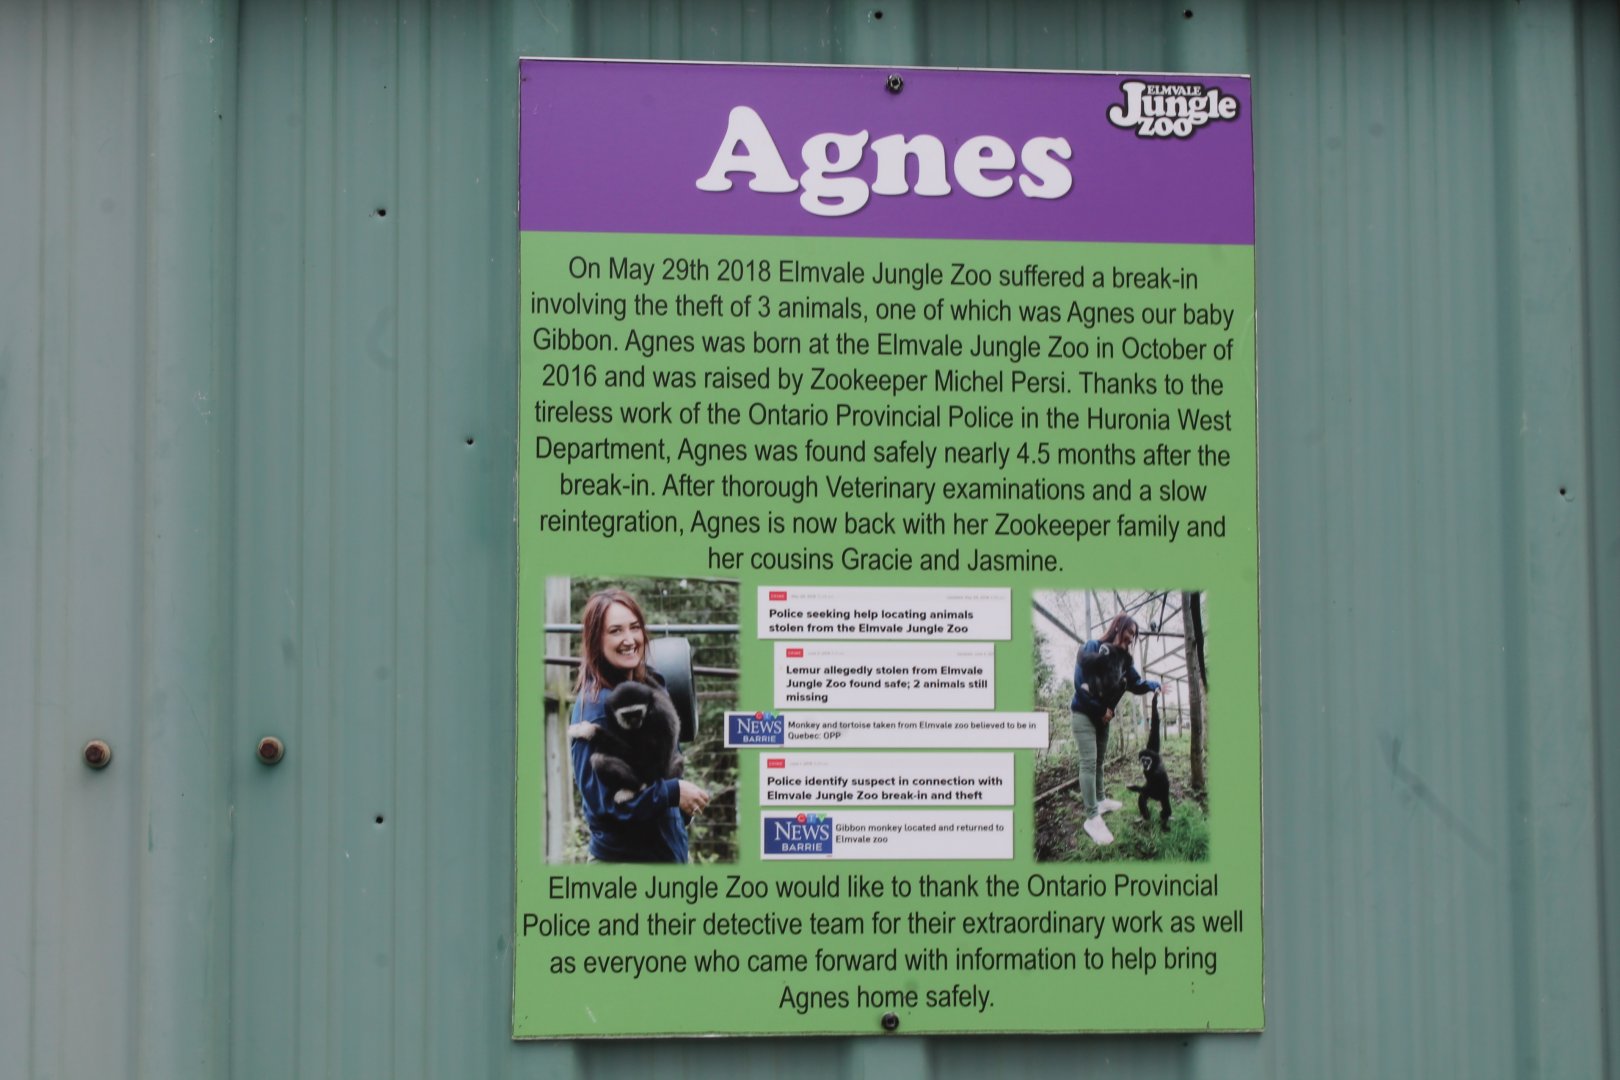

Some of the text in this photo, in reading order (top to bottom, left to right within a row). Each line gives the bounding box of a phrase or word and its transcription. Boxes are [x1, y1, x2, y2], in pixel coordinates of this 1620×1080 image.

[1147, 85, 1201, 96] ELMVALE
[1109, 81, 1237, 126] Jungle
[695, 105, 1073, 217] Agnes
[569, 256, 1197, 291] On May 29th 2018 Elmvale Jungle Zoo suffered a break-in
[532, 291, 1234, 331] involving the theft of 3 animals, one of which was Agnes our baby
[542, 364, 1223, 397] 2016 and was raised by Zookeeper Michel Persi. Thanks to the
[536, 436, 1230, 470] Department, Agnes was found safely nearly 4.5 months after the
[540, 509, 1225, 543] reintegration, Agnes is now back with her Zookeeper family and
[709, 546, 1063, 572] her cousins Gracie and Jasmine.
[769, 609, 973, 621] Police seeking help locating animals
[769, 623, 968, 635] stolen from the Elmvale Jungle Zoo
[786, 665, 983, 676] Lemur allegedly stolen from Elmvale
[787, 679, 987, 690] Jungle Zoo found safe; 2 animals still
[786, 692, 828, 703] missing
[737, 718, 782, 735] NEWS
[788, 721, 820, 730] Monkey
[822, 721, 837, 729] and
[839, 721, 871, 729] tortoise
[873, 721, 896, 729] taken
[898, 721, 917, 729] from
[919, 721, 952, 729] Elmvale
[970, 721, 1006, 729] believed
[1028, 721, 1036, 729] in
[742, 735, 777, 743] BARRIE
[788, 732, 822, 740] Quebec:
[767, 776, 1003, 788] Police identify suspect in connection with
[767, 790, 982, 802] Elmvale Jungle Zoo break-in and theft
[774, 821, 830, 841] NEWS
[868, 824, 902, 833] monkey
[836, 835, 870, 843] Elmvale
[781, 842, 823, 852] BARRIE
[549, 873, 1218, 905] Elmvale Jungle Zoo would like to thank the Ontario Provincial
[550, 946, 1217, 979] as everyone who came forward with information to help bring
[779, 984, 994, 1013] Agnes home safely.
